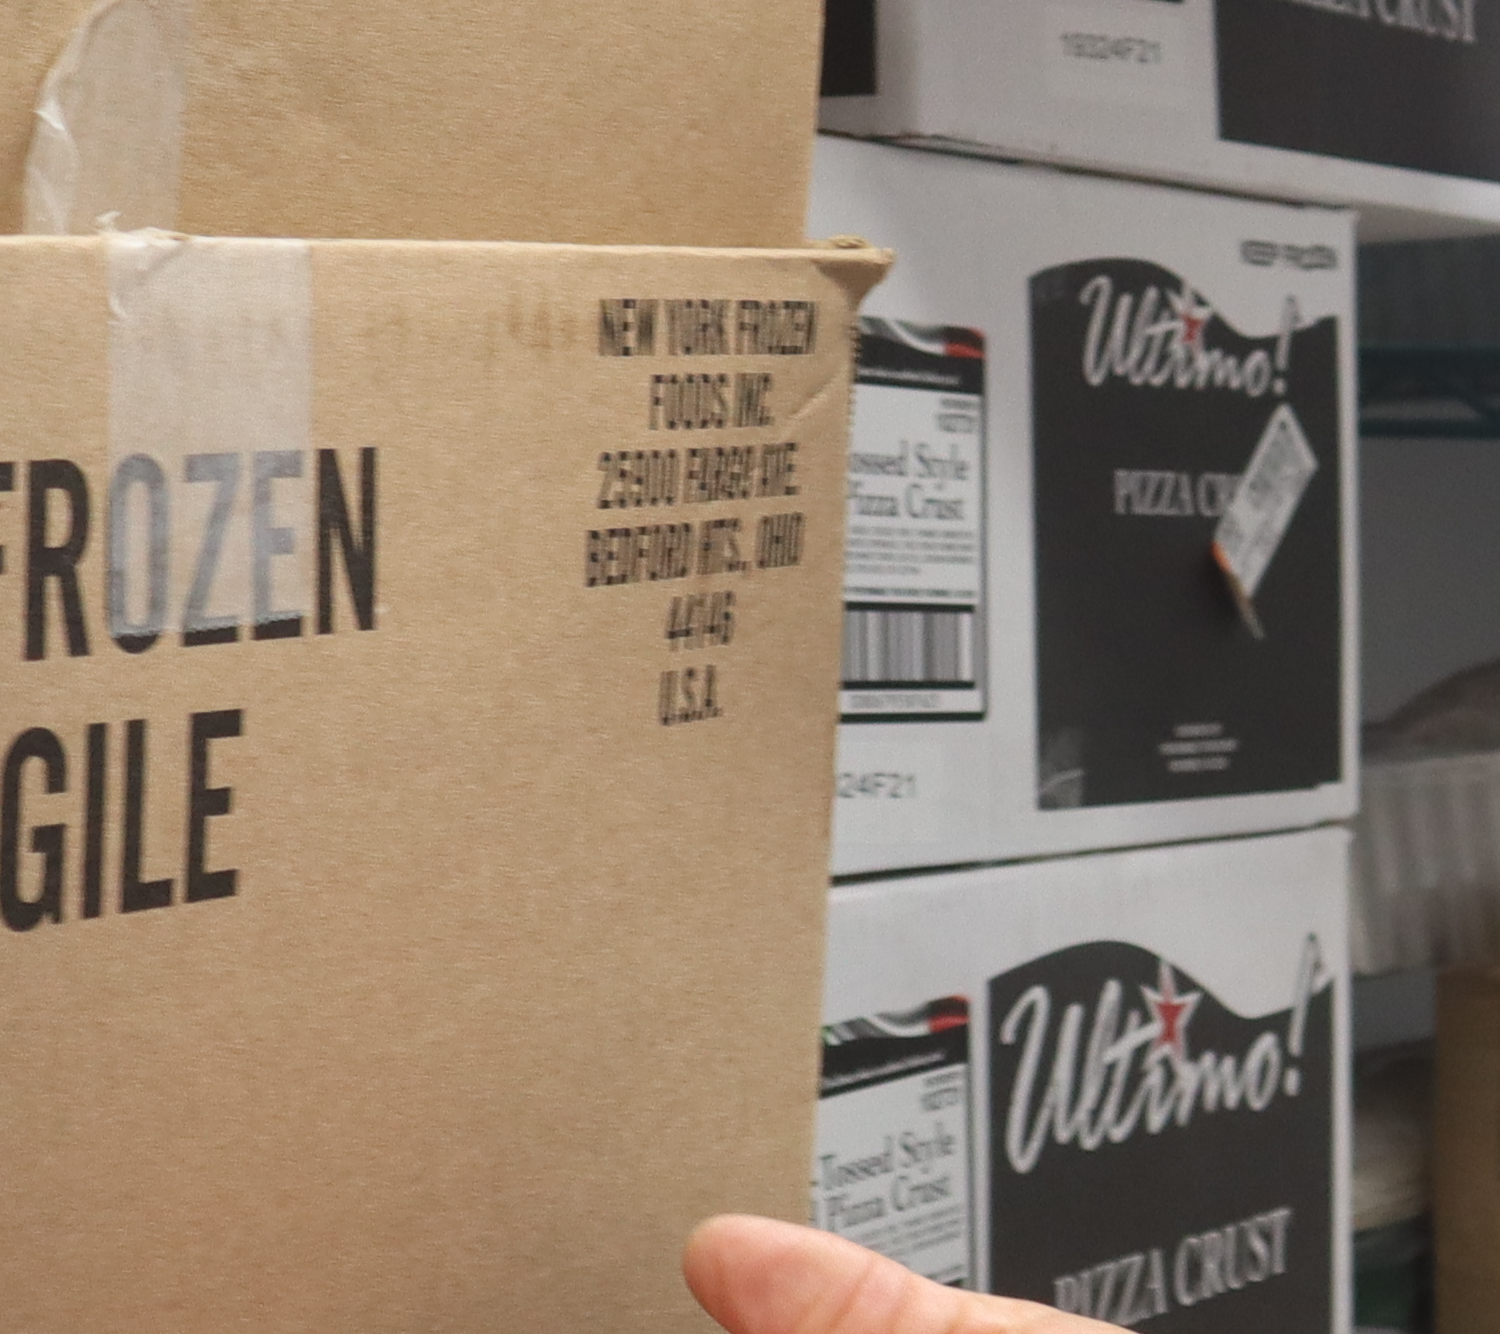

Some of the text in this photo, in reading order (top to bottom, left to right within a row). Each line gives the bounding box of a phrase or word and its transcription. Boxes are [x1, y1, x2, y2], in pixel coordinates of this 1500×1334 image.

[598, 298, 820, 357] NEW YORK FROZEN
[648, 372, 729, 431] FOODS
[1112, 468, 1195, 517] PIZZA
[584, 521, 694, 588] BEDFORD
[755, 511, 806, 570] OHIO
[1000, 933, 1317, 1174] Ultimo!
[1053, 1207, 1295, 1328] PIZZA CRUST
